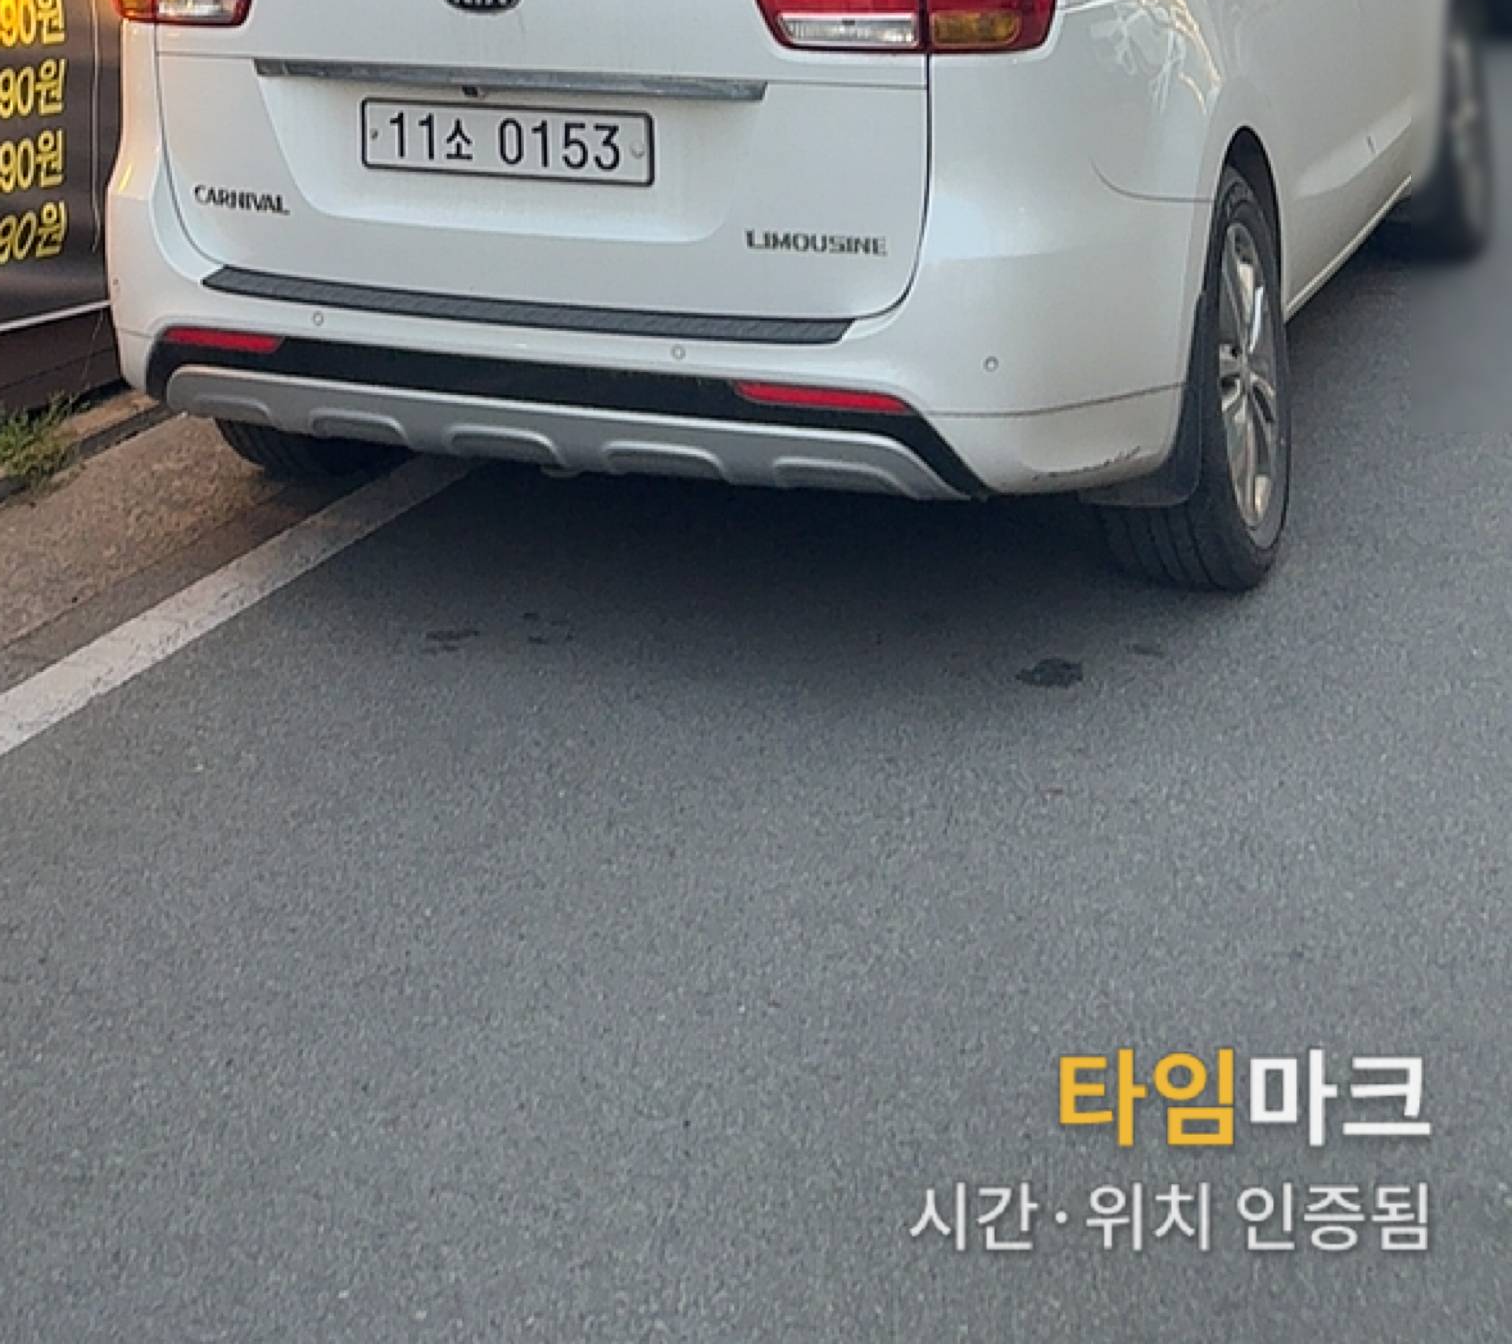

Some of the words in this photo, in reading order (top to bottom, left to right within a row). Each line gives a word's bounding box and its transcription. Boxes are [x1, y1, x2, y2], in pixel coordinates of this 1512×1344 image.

[388, 111, 475, 162] 11소
[498, 117, 622, 172] 0153
[192, 183, 291, 216] CARNIVAL
[744, 226, 889, 257] LIMOUSINE
